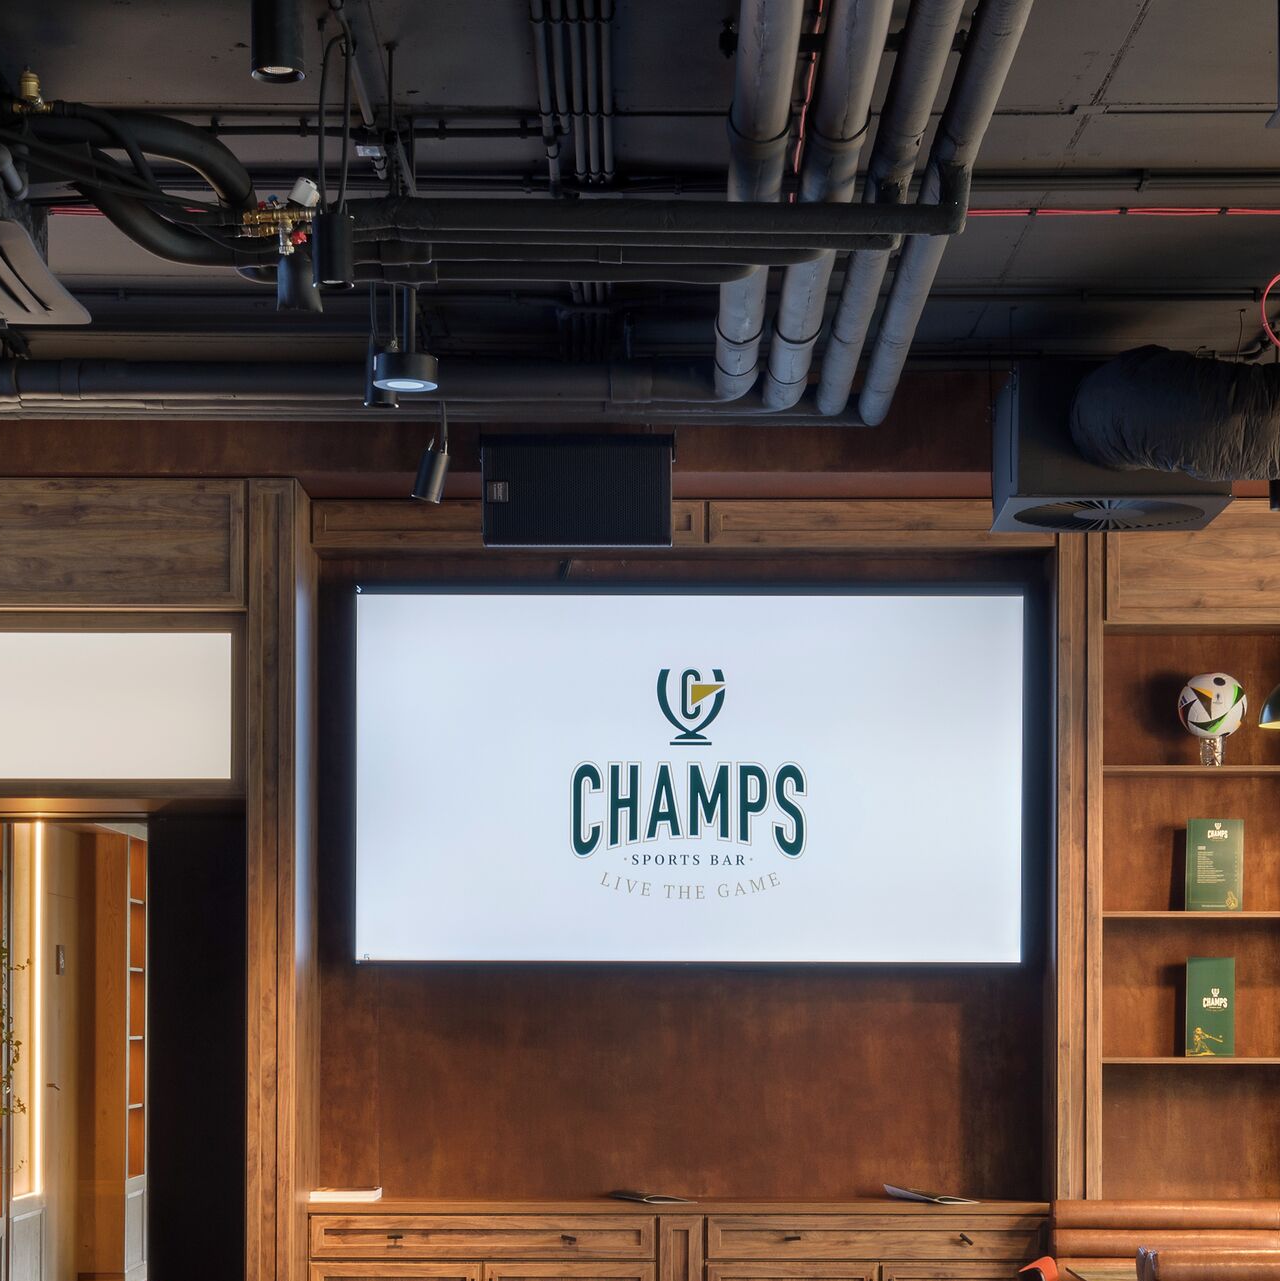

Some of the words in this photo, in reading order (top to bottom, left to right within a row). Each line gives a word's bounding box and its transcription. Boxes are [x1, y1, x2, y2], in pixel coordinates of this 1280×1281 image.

[570, 760, 808, 859] CHAMPS
[631, 854, 701, 866] SPORTS
[710, 854, 746, 866] BAR
[599, 872, 652, 897] LIVE
[664, 884, 706, 900] THE
[717, 871, 781, 898] GAME
[1203, 997, 1228, 1008] CHAMPS
